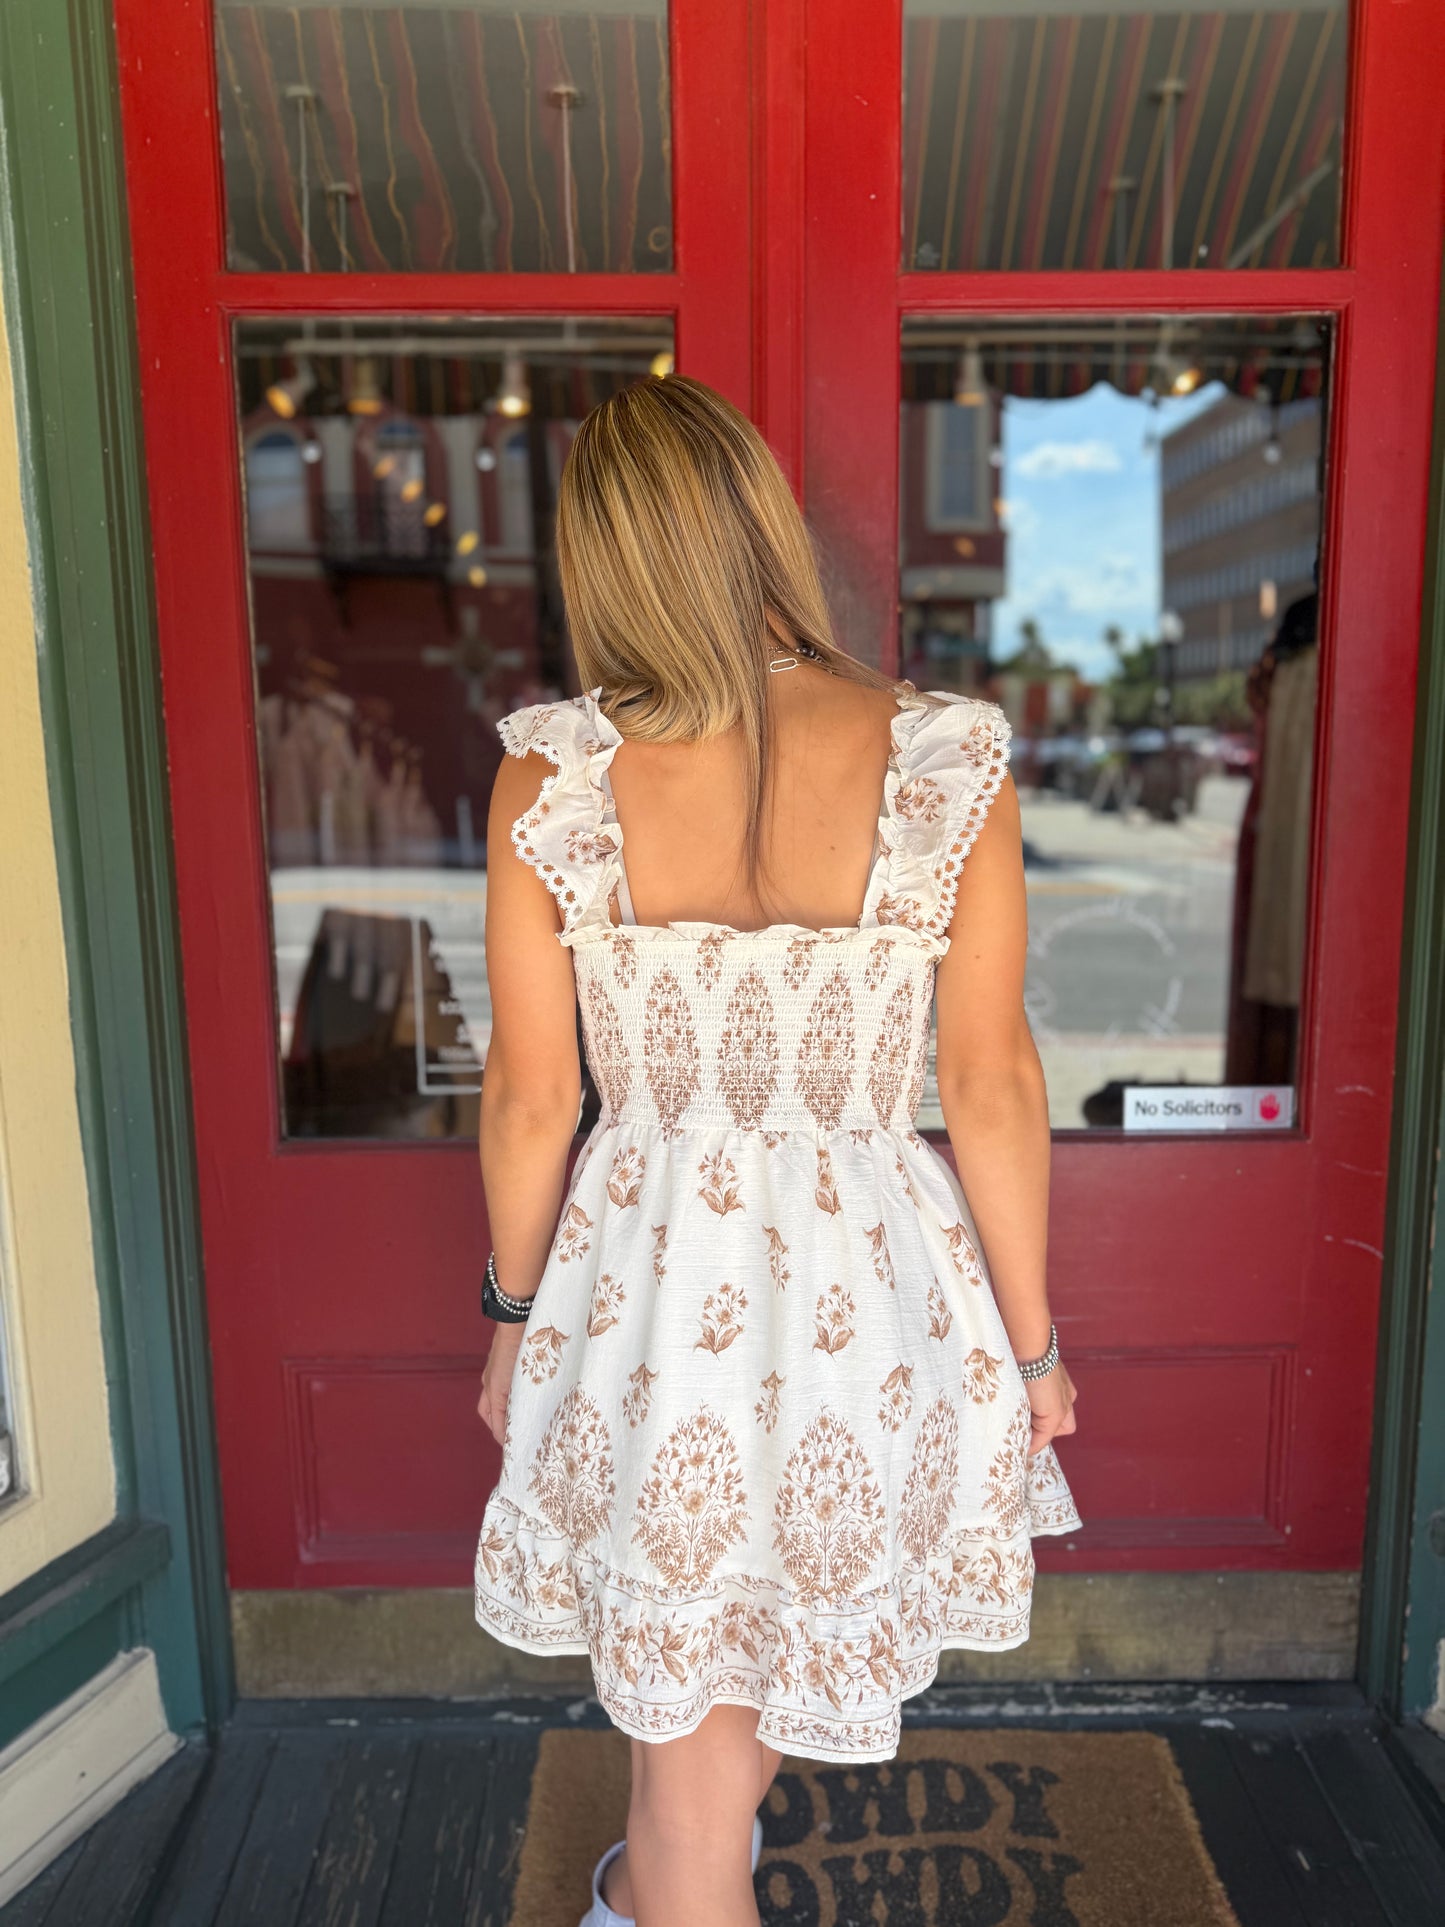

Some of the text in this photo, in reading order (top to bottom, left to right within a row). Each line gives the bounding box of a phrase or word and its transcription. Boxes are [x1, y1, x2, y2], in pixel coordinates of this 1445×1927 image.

[1135, 1099, 1243, 1116] No Solicitors
[757, 1759, 1061, 1844] OWDY
[752, 1845, 1085, 1927] OWDY
